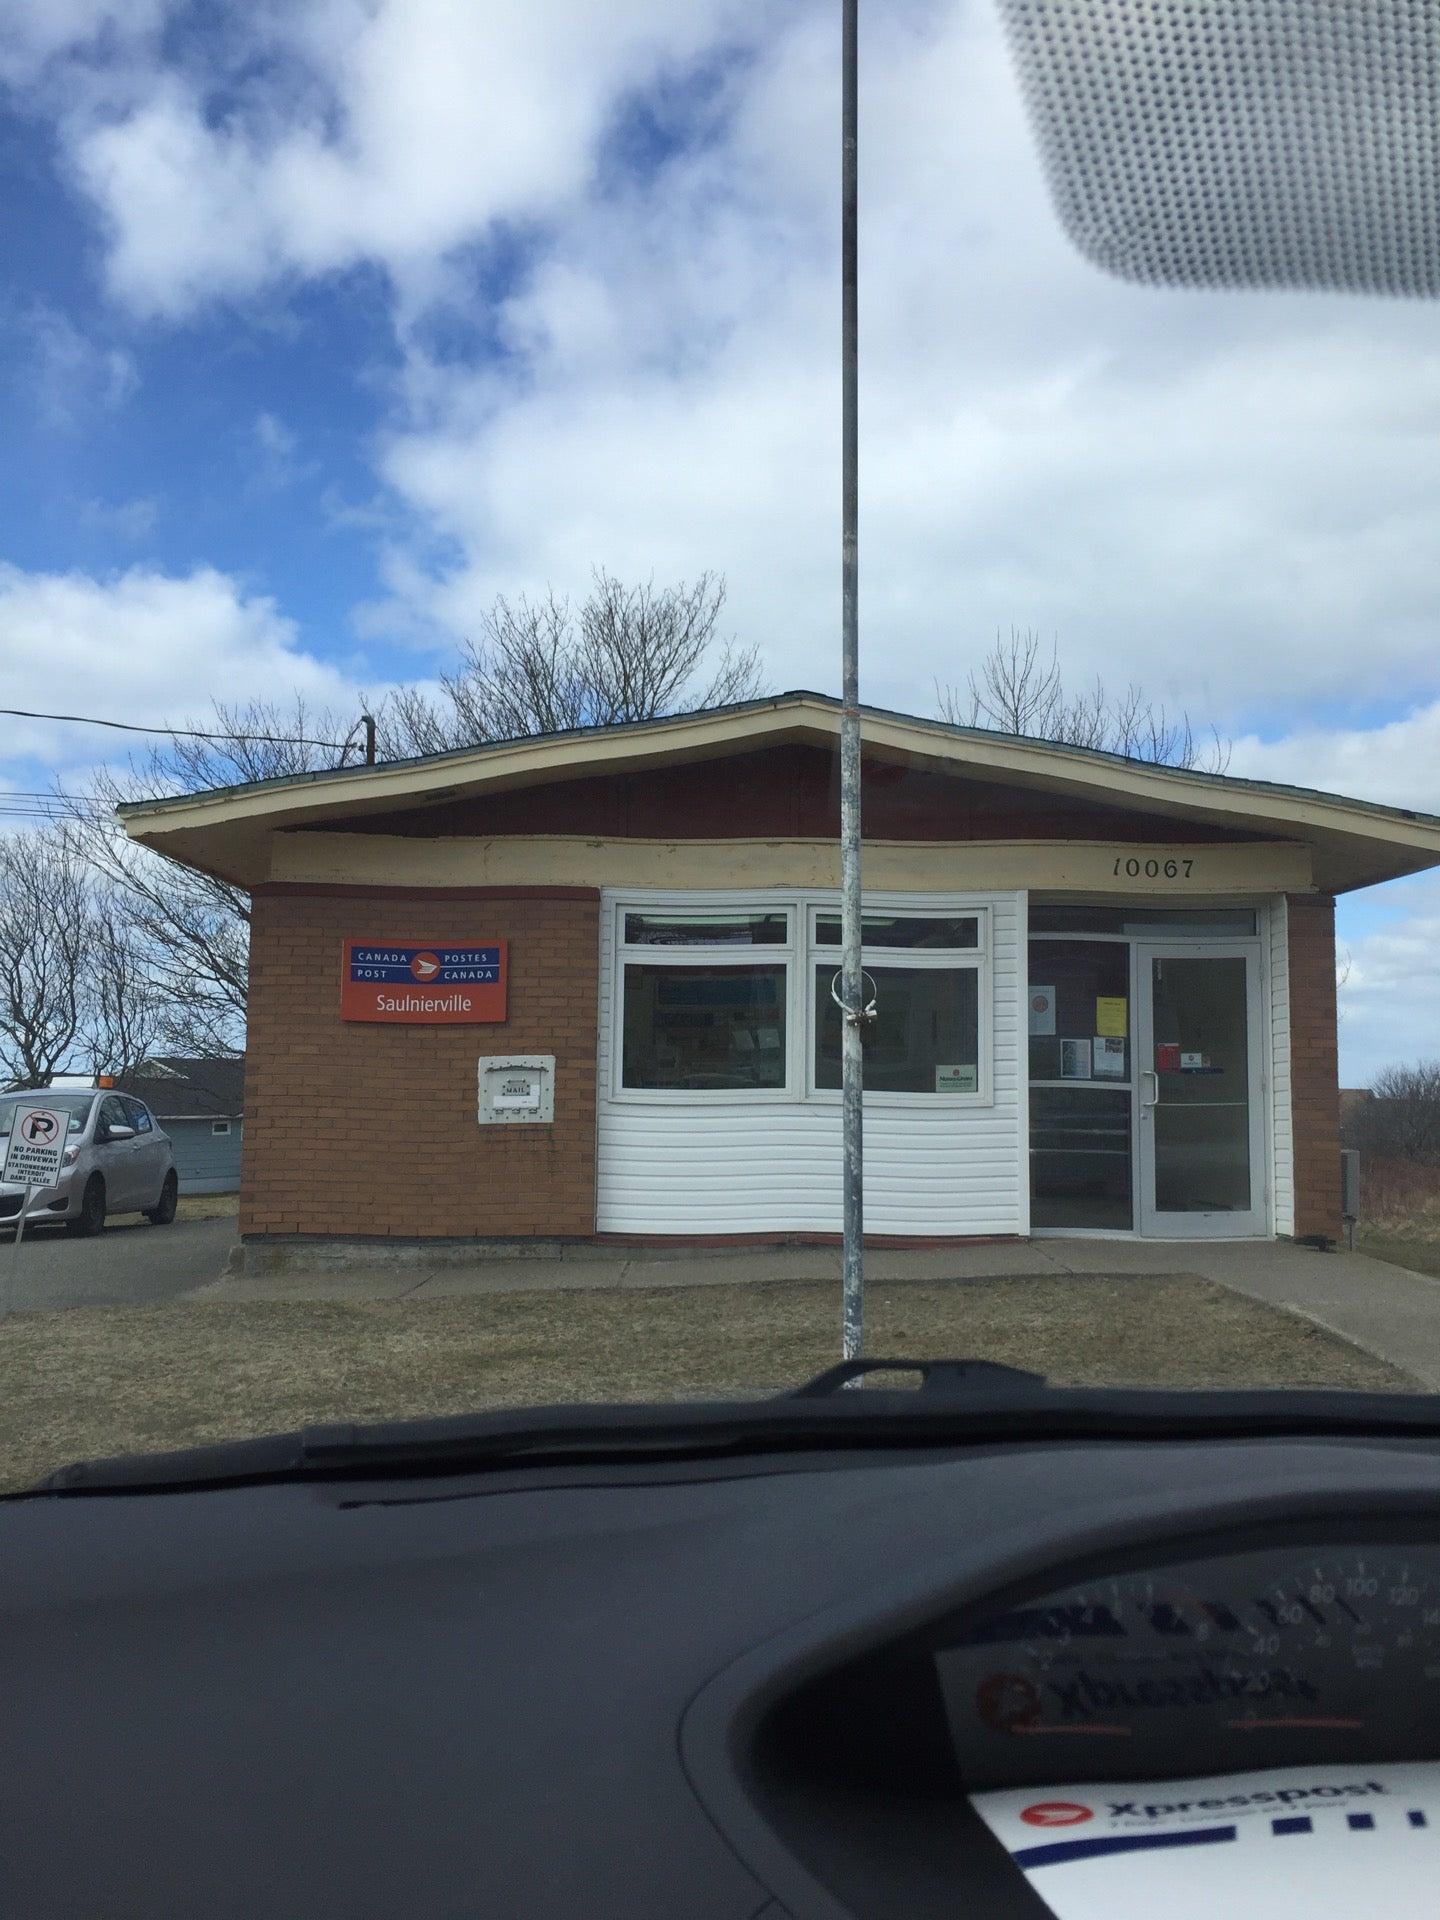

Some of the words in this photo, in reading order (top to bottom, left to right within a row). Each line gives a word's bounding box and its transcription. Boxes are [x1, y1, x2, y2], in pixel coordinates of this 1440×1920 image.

[1113, 857, 1194, 878] 10067
[358, 952, 407, 962] CANADA
[444, 953, 487, 962] POSTES
[357, 969, 387, 978] POST
[444, 970, 493, 980] CANADA
[376, 994, 472, 1012] Saulnierville
[14, 1145, 24, 1153] NO
[26, 1147, 58, 1157] PARKING
[20, 1154, 58, 1164] DRIVEWAY
[8, 1161, 58, 1173] STATIONNEMENT
[17, 1169, 46, 1177] INTERDIT
[1345, 1577, 1379, 1597] 100
[1308, 1583, 1336, 1604] 80
[1252, 1633, 1281, 1656] 40
[1108, 1780, 1385, 1818] Xpresspost
